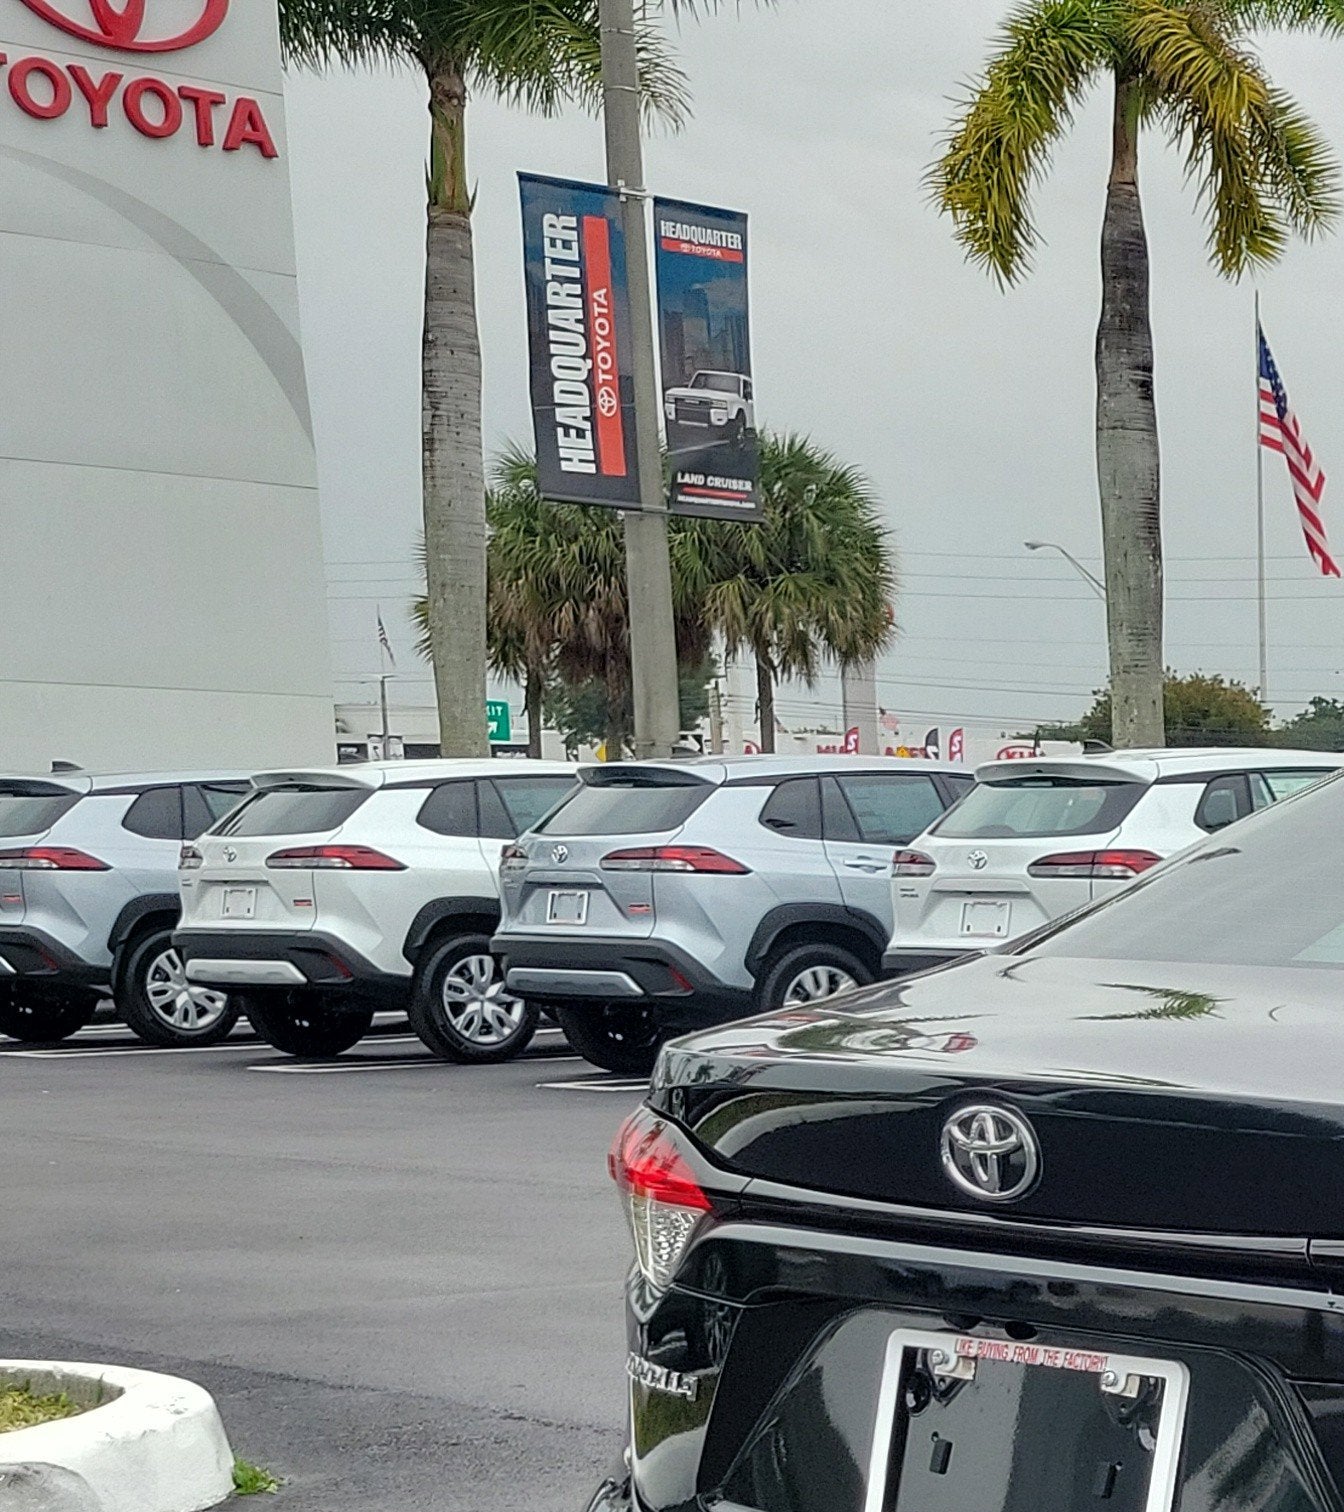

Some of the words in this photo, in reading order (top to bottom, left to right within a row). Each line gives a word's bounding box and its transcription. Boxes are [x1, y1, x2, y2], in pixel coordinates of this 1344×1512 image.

[0, 53, 279, 159] OYOTA
[660, 220, 742, 250] HEADQUARTER
[543, 213, 597, 474] HEADQUARTER
[594, 288, 613, 383] TOYOTA
[677, 472, 705, 485] LAND
[706, 476, 753, 491] CRUISER
[955, 1338, 973, 1355] LIKE
[977, 1340, 1009, 1360] BUYING
[1013, 1345, 1039, 1365] FROM
[1043, 1349, 1060, 1367] THE
